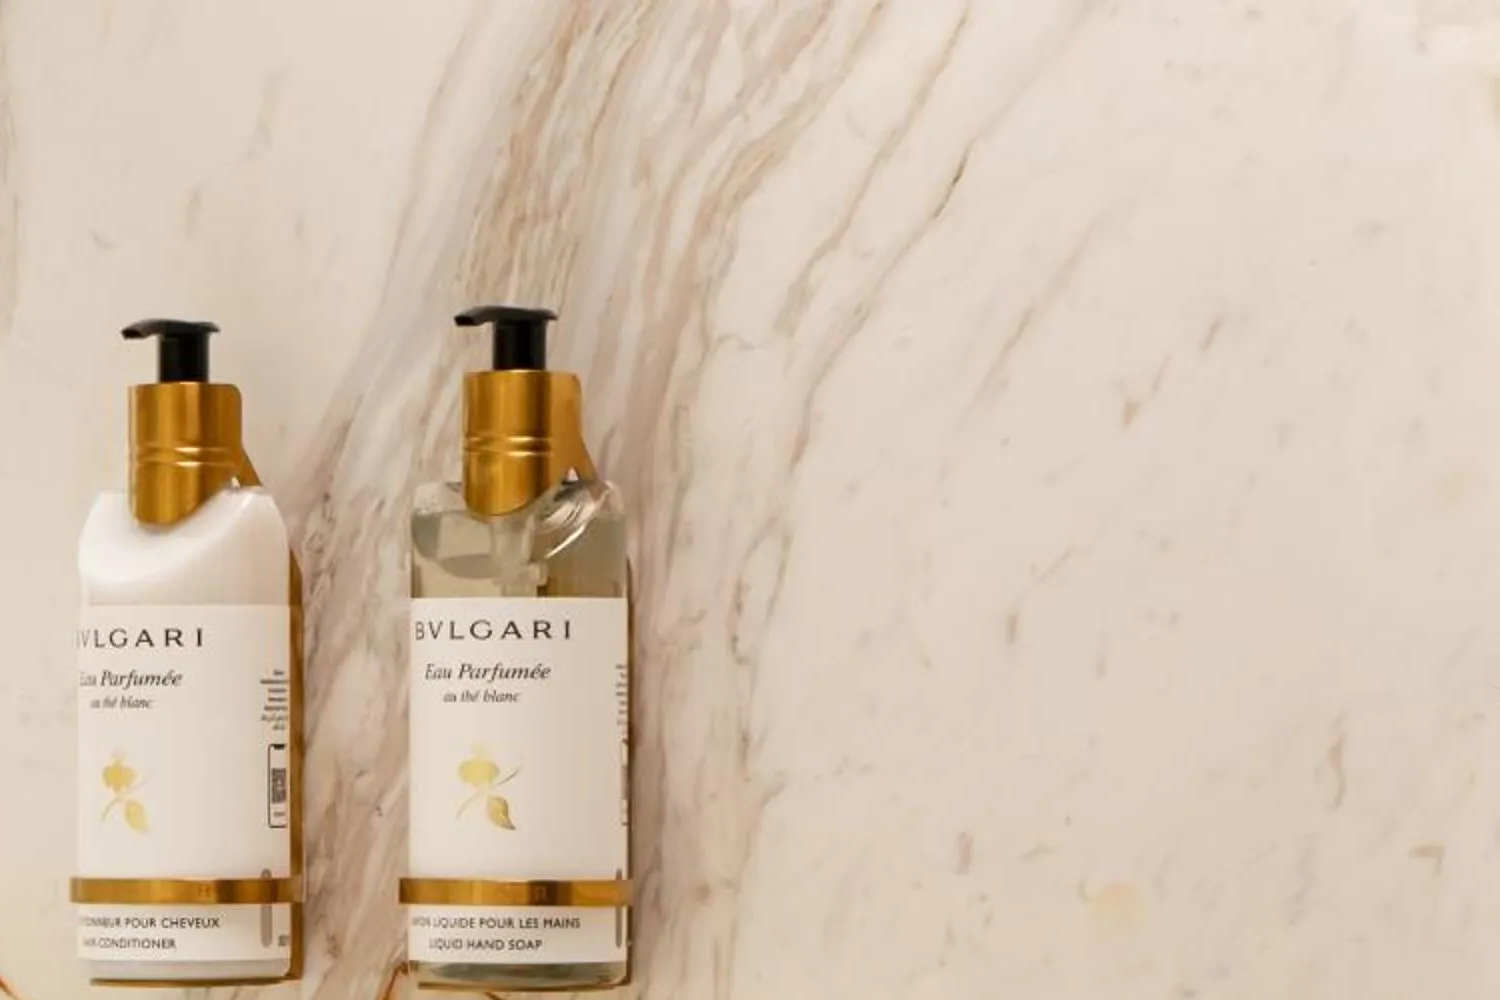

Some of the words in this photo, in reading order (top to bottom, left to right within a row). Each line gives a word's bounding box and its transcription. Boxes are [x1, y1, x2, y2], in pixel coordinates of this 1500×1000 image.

[414, 619, 571, 641] BVLGARI
[100, 668, 183, 690] Parfumée
[424, 663, 452, 681] Eau
[457, 662, 551, 684] Parfumée
[119, 695, 153, 709] blanc
[460, 690, 480, 703] thé
[483, 690, 521, 703] blanc
[125, 917, 157, 929] POUR
[161, 917, 221, 929] CHEVEUX
[433, 916, 477, 929] LIQUIDE
[479, 916, 514, 929] POUR
[519, 916, 540, 929] LES
[543, 916, 581, 929] MAINS
[98, 937, 177, 949] CONDITIONER
[428, 937, 463, 950] LIQUID
[466, 938, 505, 950] HAND
[508, 938, 543, 950] SOAP
